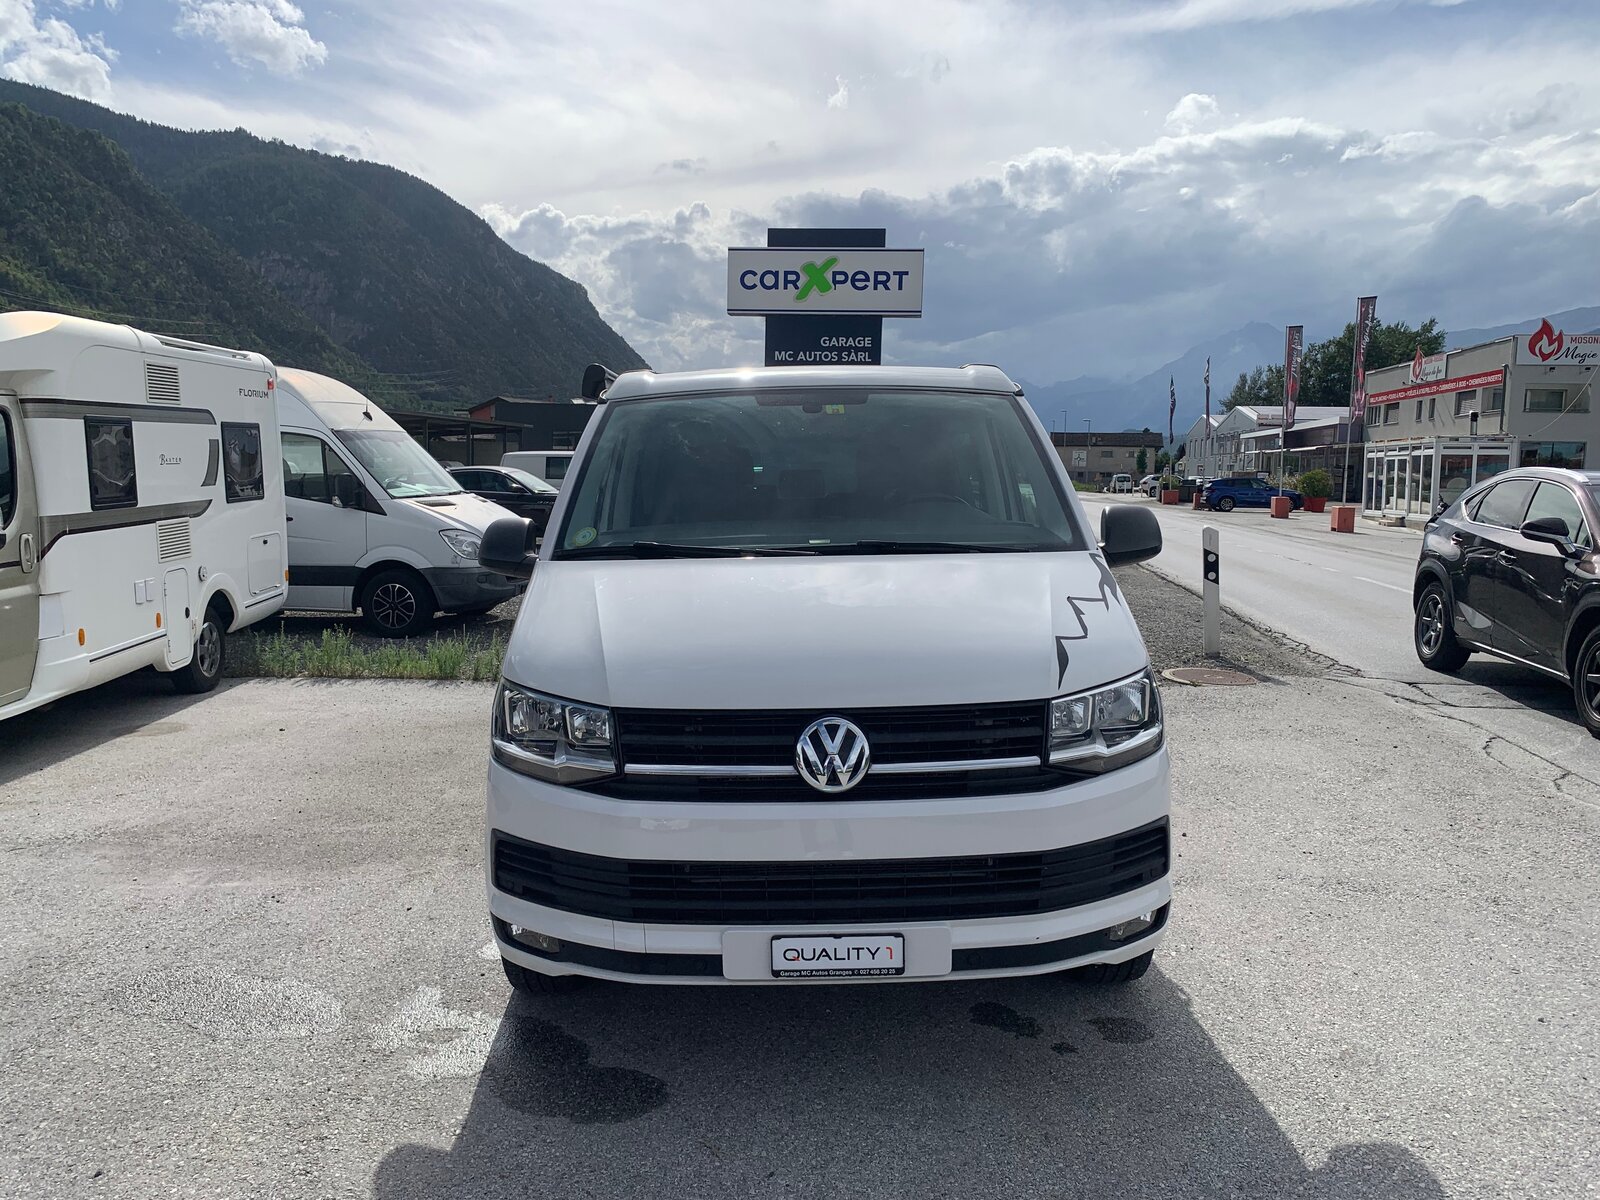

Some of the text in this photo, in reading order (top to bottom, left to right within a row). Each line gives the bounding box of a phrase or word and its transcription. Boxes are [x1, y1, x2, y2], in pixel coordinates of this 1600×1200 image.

[820, 337, 872, 347] GARAGE
[774, 349, 872, 361] MC AUTOS SÀRL
[1553, 345, 1599, 364] Magie
[238, 388, 269, 399] FLORIUM
[782, 946, 893, 962] QUALITY 1
